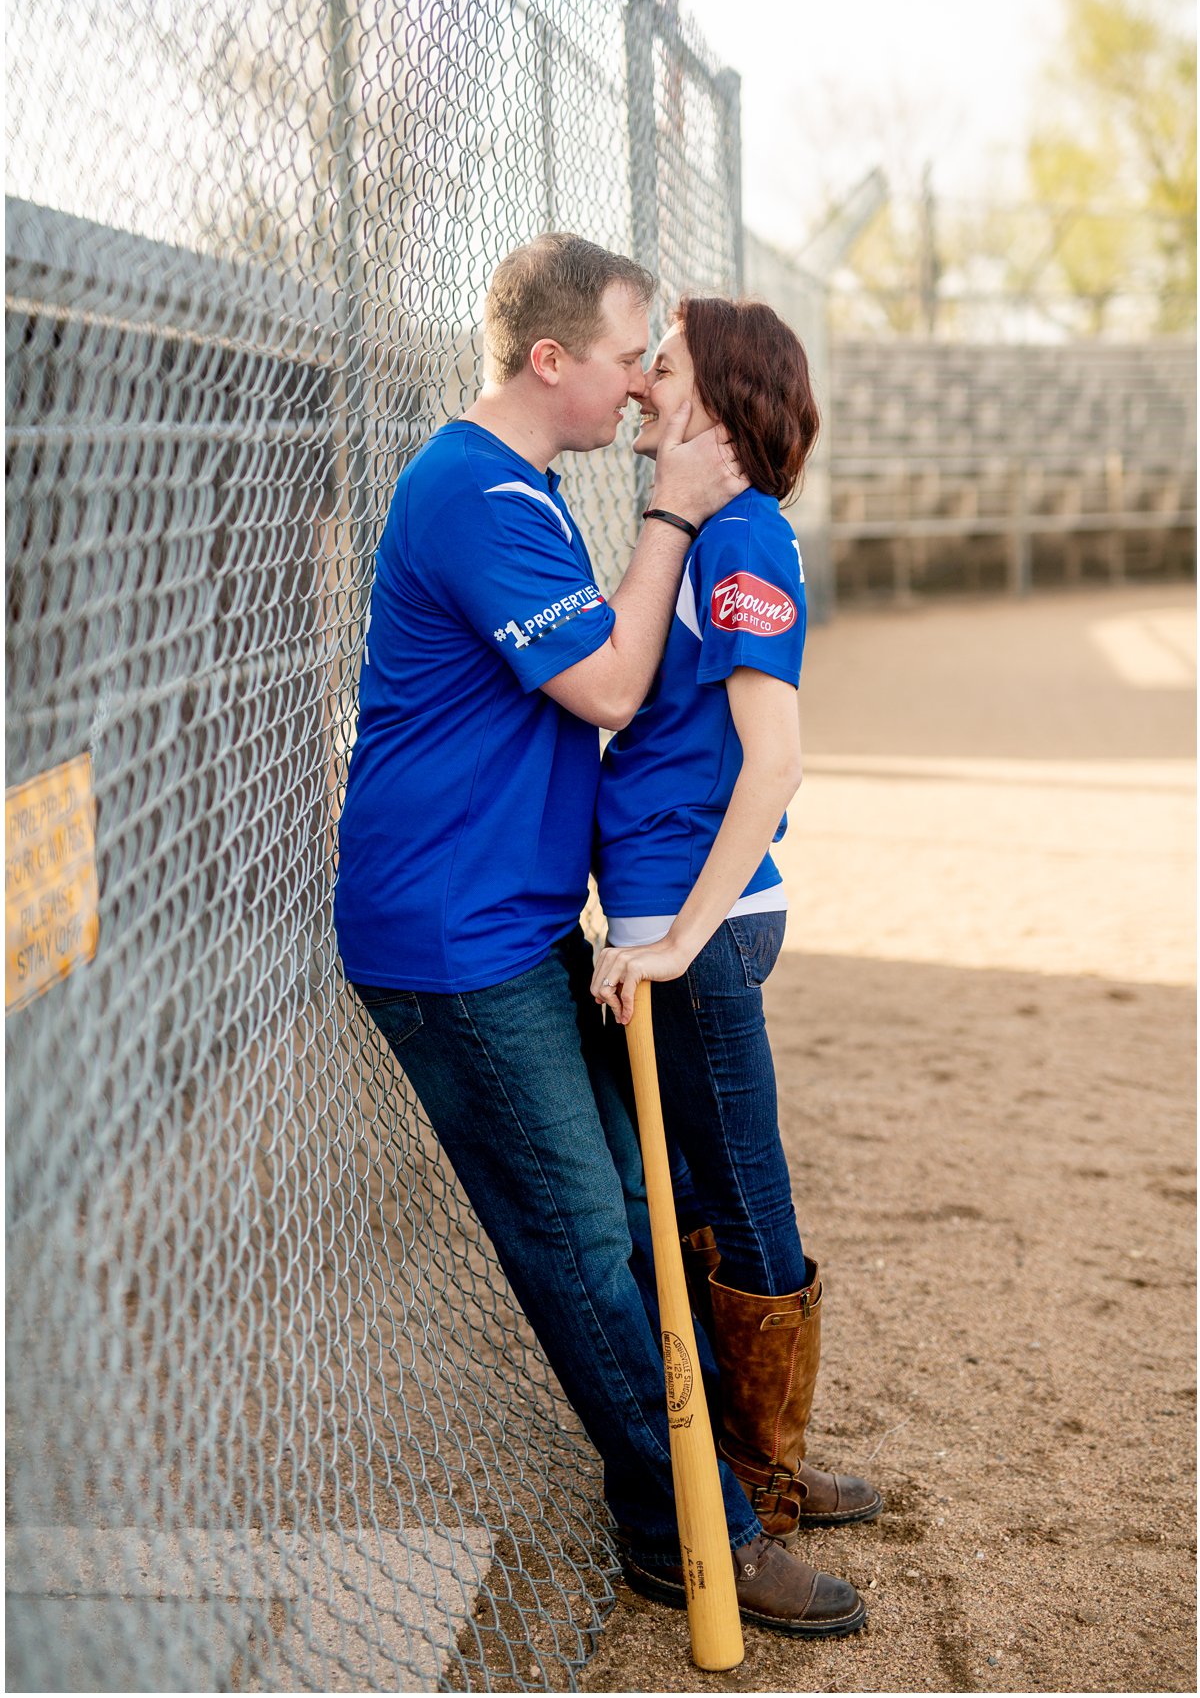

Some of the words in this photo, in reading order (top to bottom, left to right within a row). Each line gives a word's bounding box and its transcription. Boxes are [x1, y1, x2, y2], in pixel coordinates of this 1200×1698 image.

[523, 583, 602, 635] PROPERTIES
[714, 583, 794, 622] Brown's
[749, 615, 760, 627] FIT
[17, 931, 51, 983] STAY
[673, 1363, 683, 1379] 125
[696, 1560, 706, 1589] GENUINE
